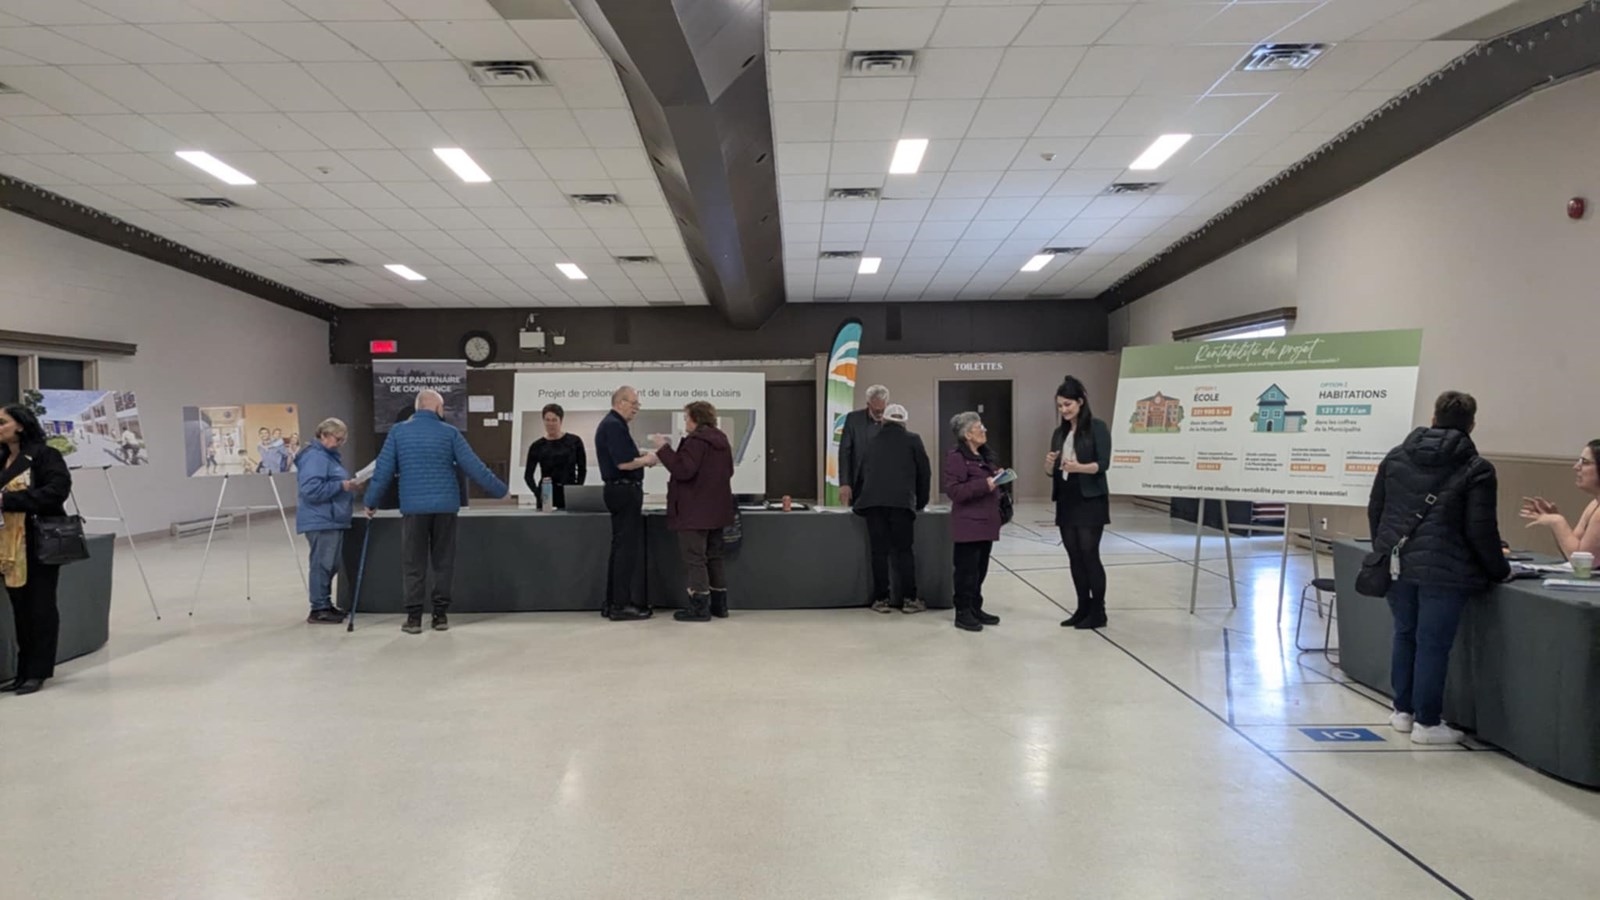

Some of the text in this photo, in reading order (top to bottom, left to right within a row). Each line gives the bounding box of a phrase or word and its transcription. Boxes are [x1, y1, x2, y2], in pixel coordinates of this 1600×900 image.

[1194, 338, 1325, 363] Rentabilité du projet
[954, 362, 1003, 371] TOILETTES
[379, 376, 461, 384] VOTRE PARTENAIRE
[390, 385, 401, 393] DE
[538, 388, 566, 400] Projet
[568, 388, 580, 398] de
[648, 388, 660, 398] de
[662, 388, 672, 398] la
[673, 390, 689, 398] rue
[691, 388, 709, 398] des
[711, 388, 742, 398] Loisirs
[1193, 391, 1219, 401] ÉCOLE
[1319, 389, 1387, 400] HABITATIONS
